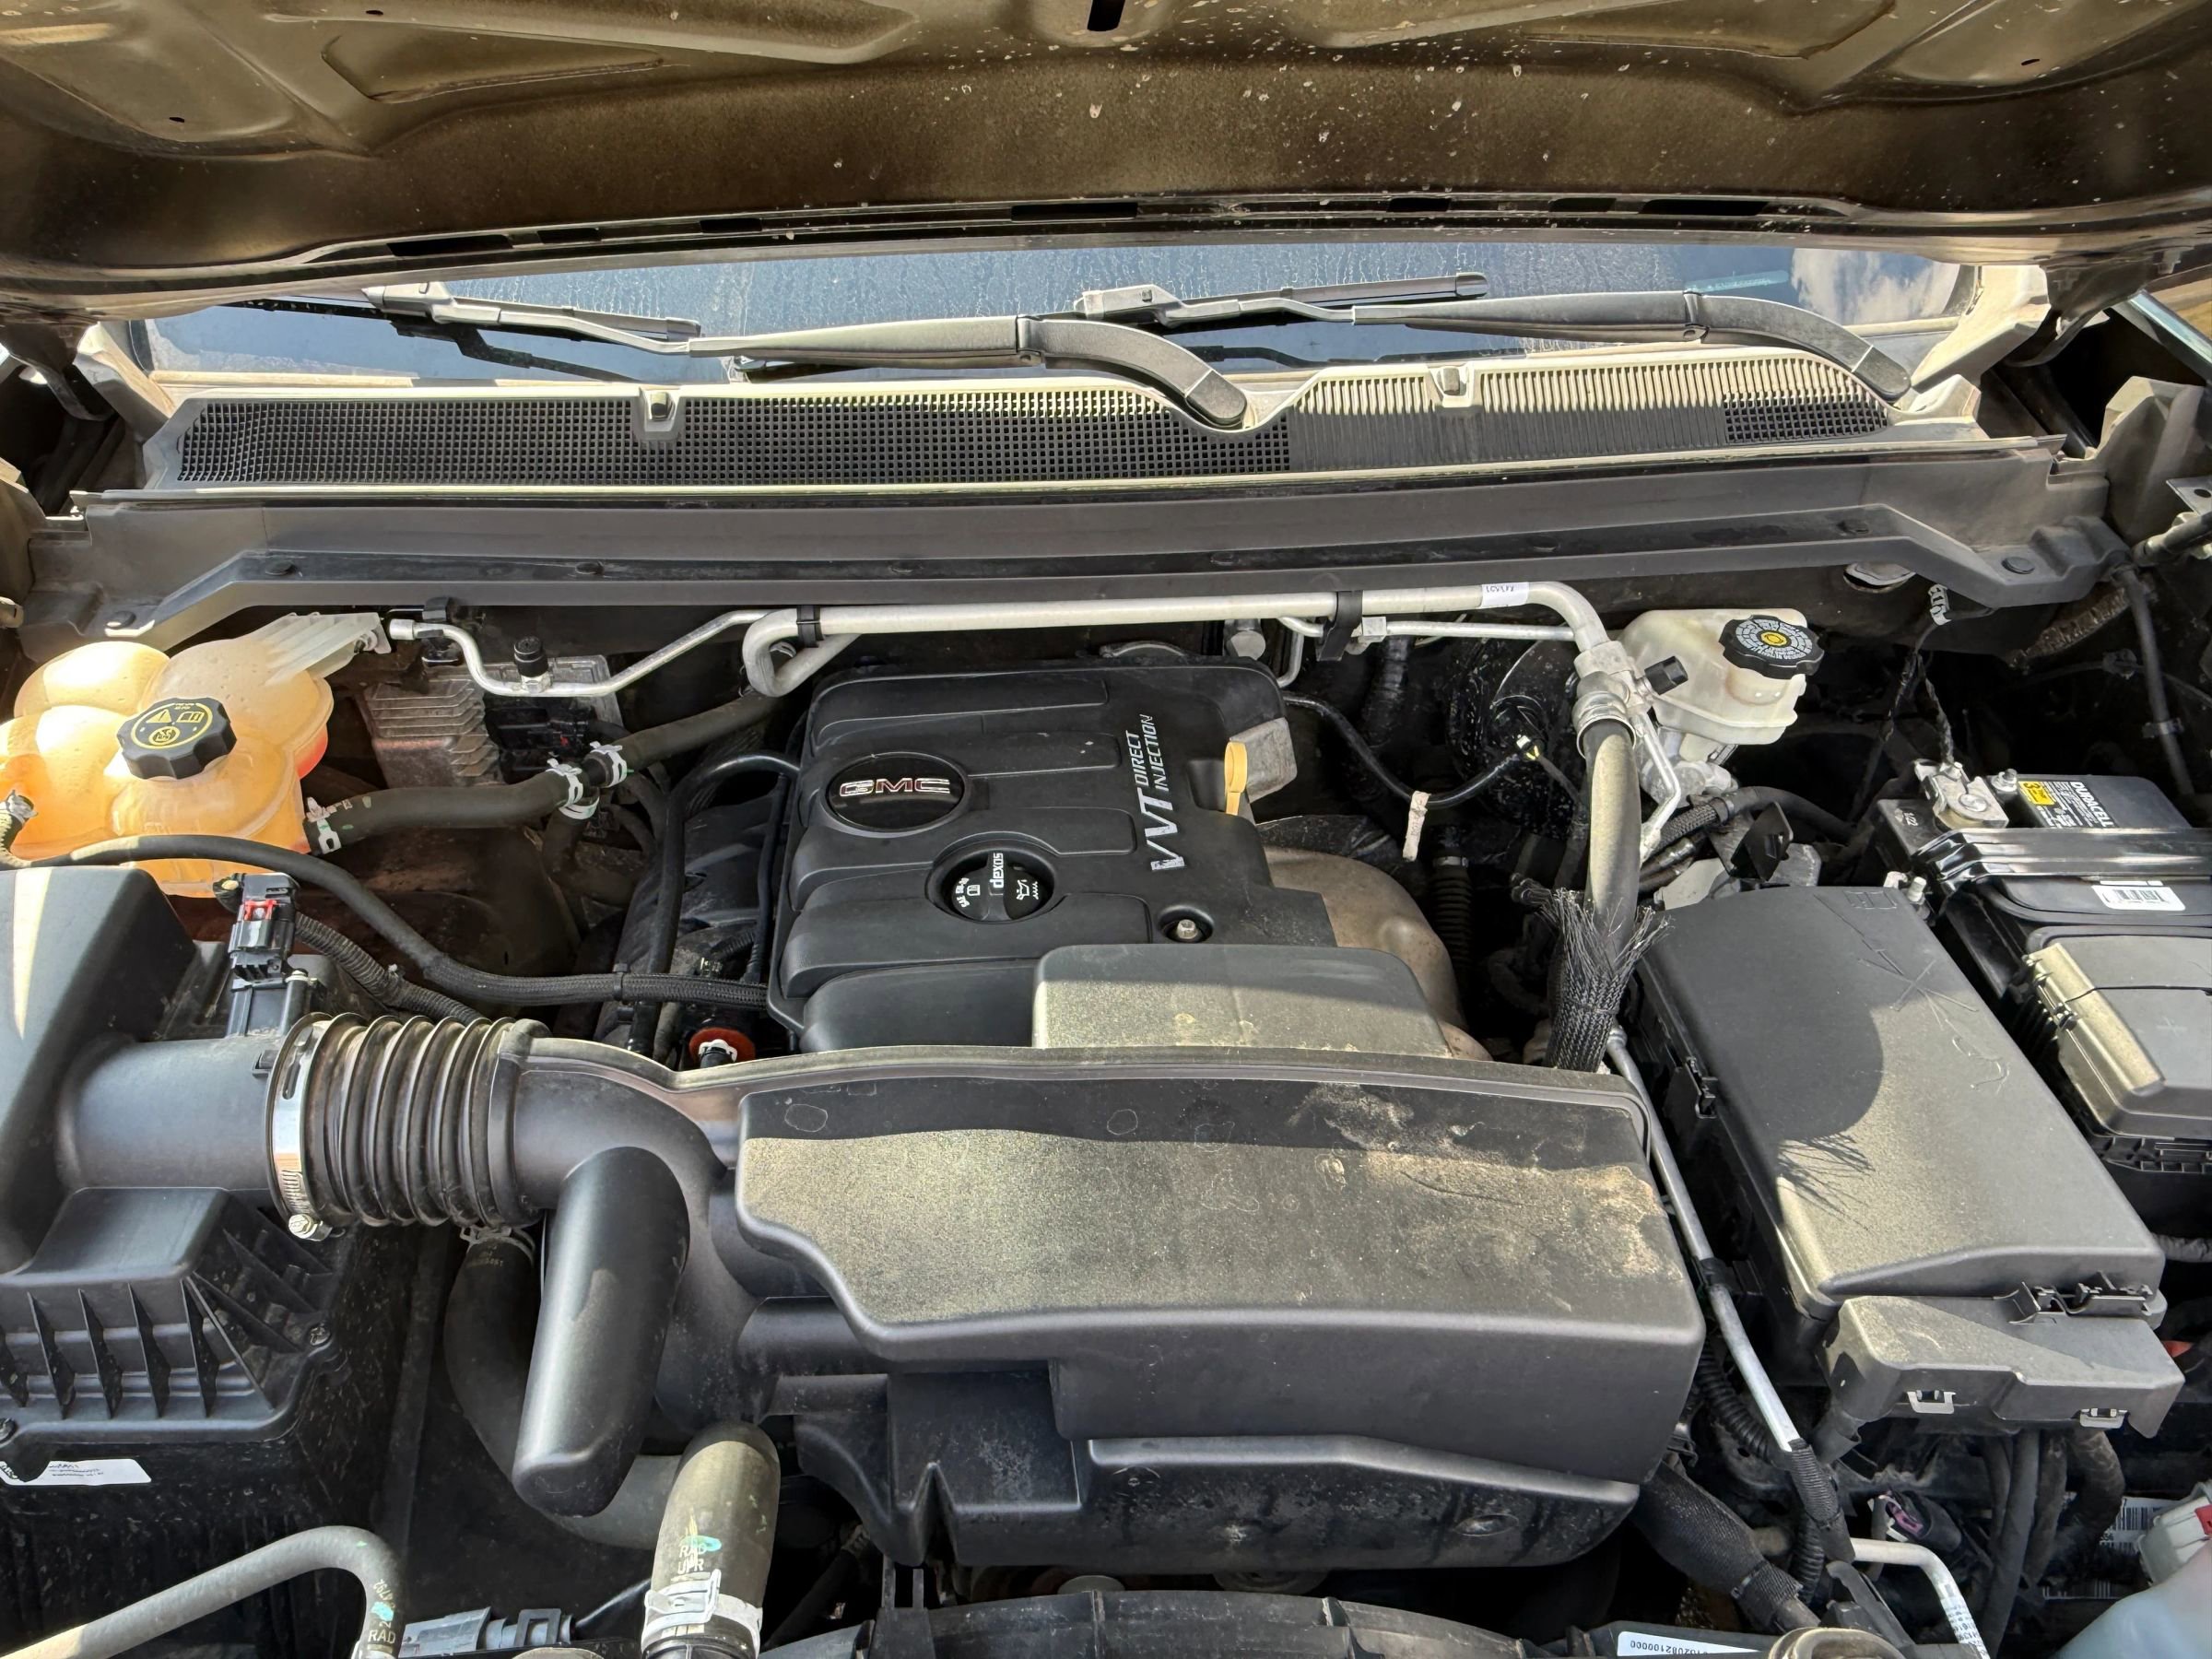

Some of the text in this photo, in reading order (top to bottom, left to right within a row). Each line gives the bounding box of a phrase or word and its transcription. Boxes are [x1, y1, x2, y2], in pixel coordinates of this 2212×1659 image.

[1125, 729, 1149, 786] DIRECT
[1139, 713, 1170, 792] INJECTION
[839, 777, 951, 797] GMC
[2069, 781, 2115, 828] DURACELL
[1136, 786, 1185, 871] VVT
[989, 852, 1005, 888] dexos
[368, 1629, 396, 1644] RAD
